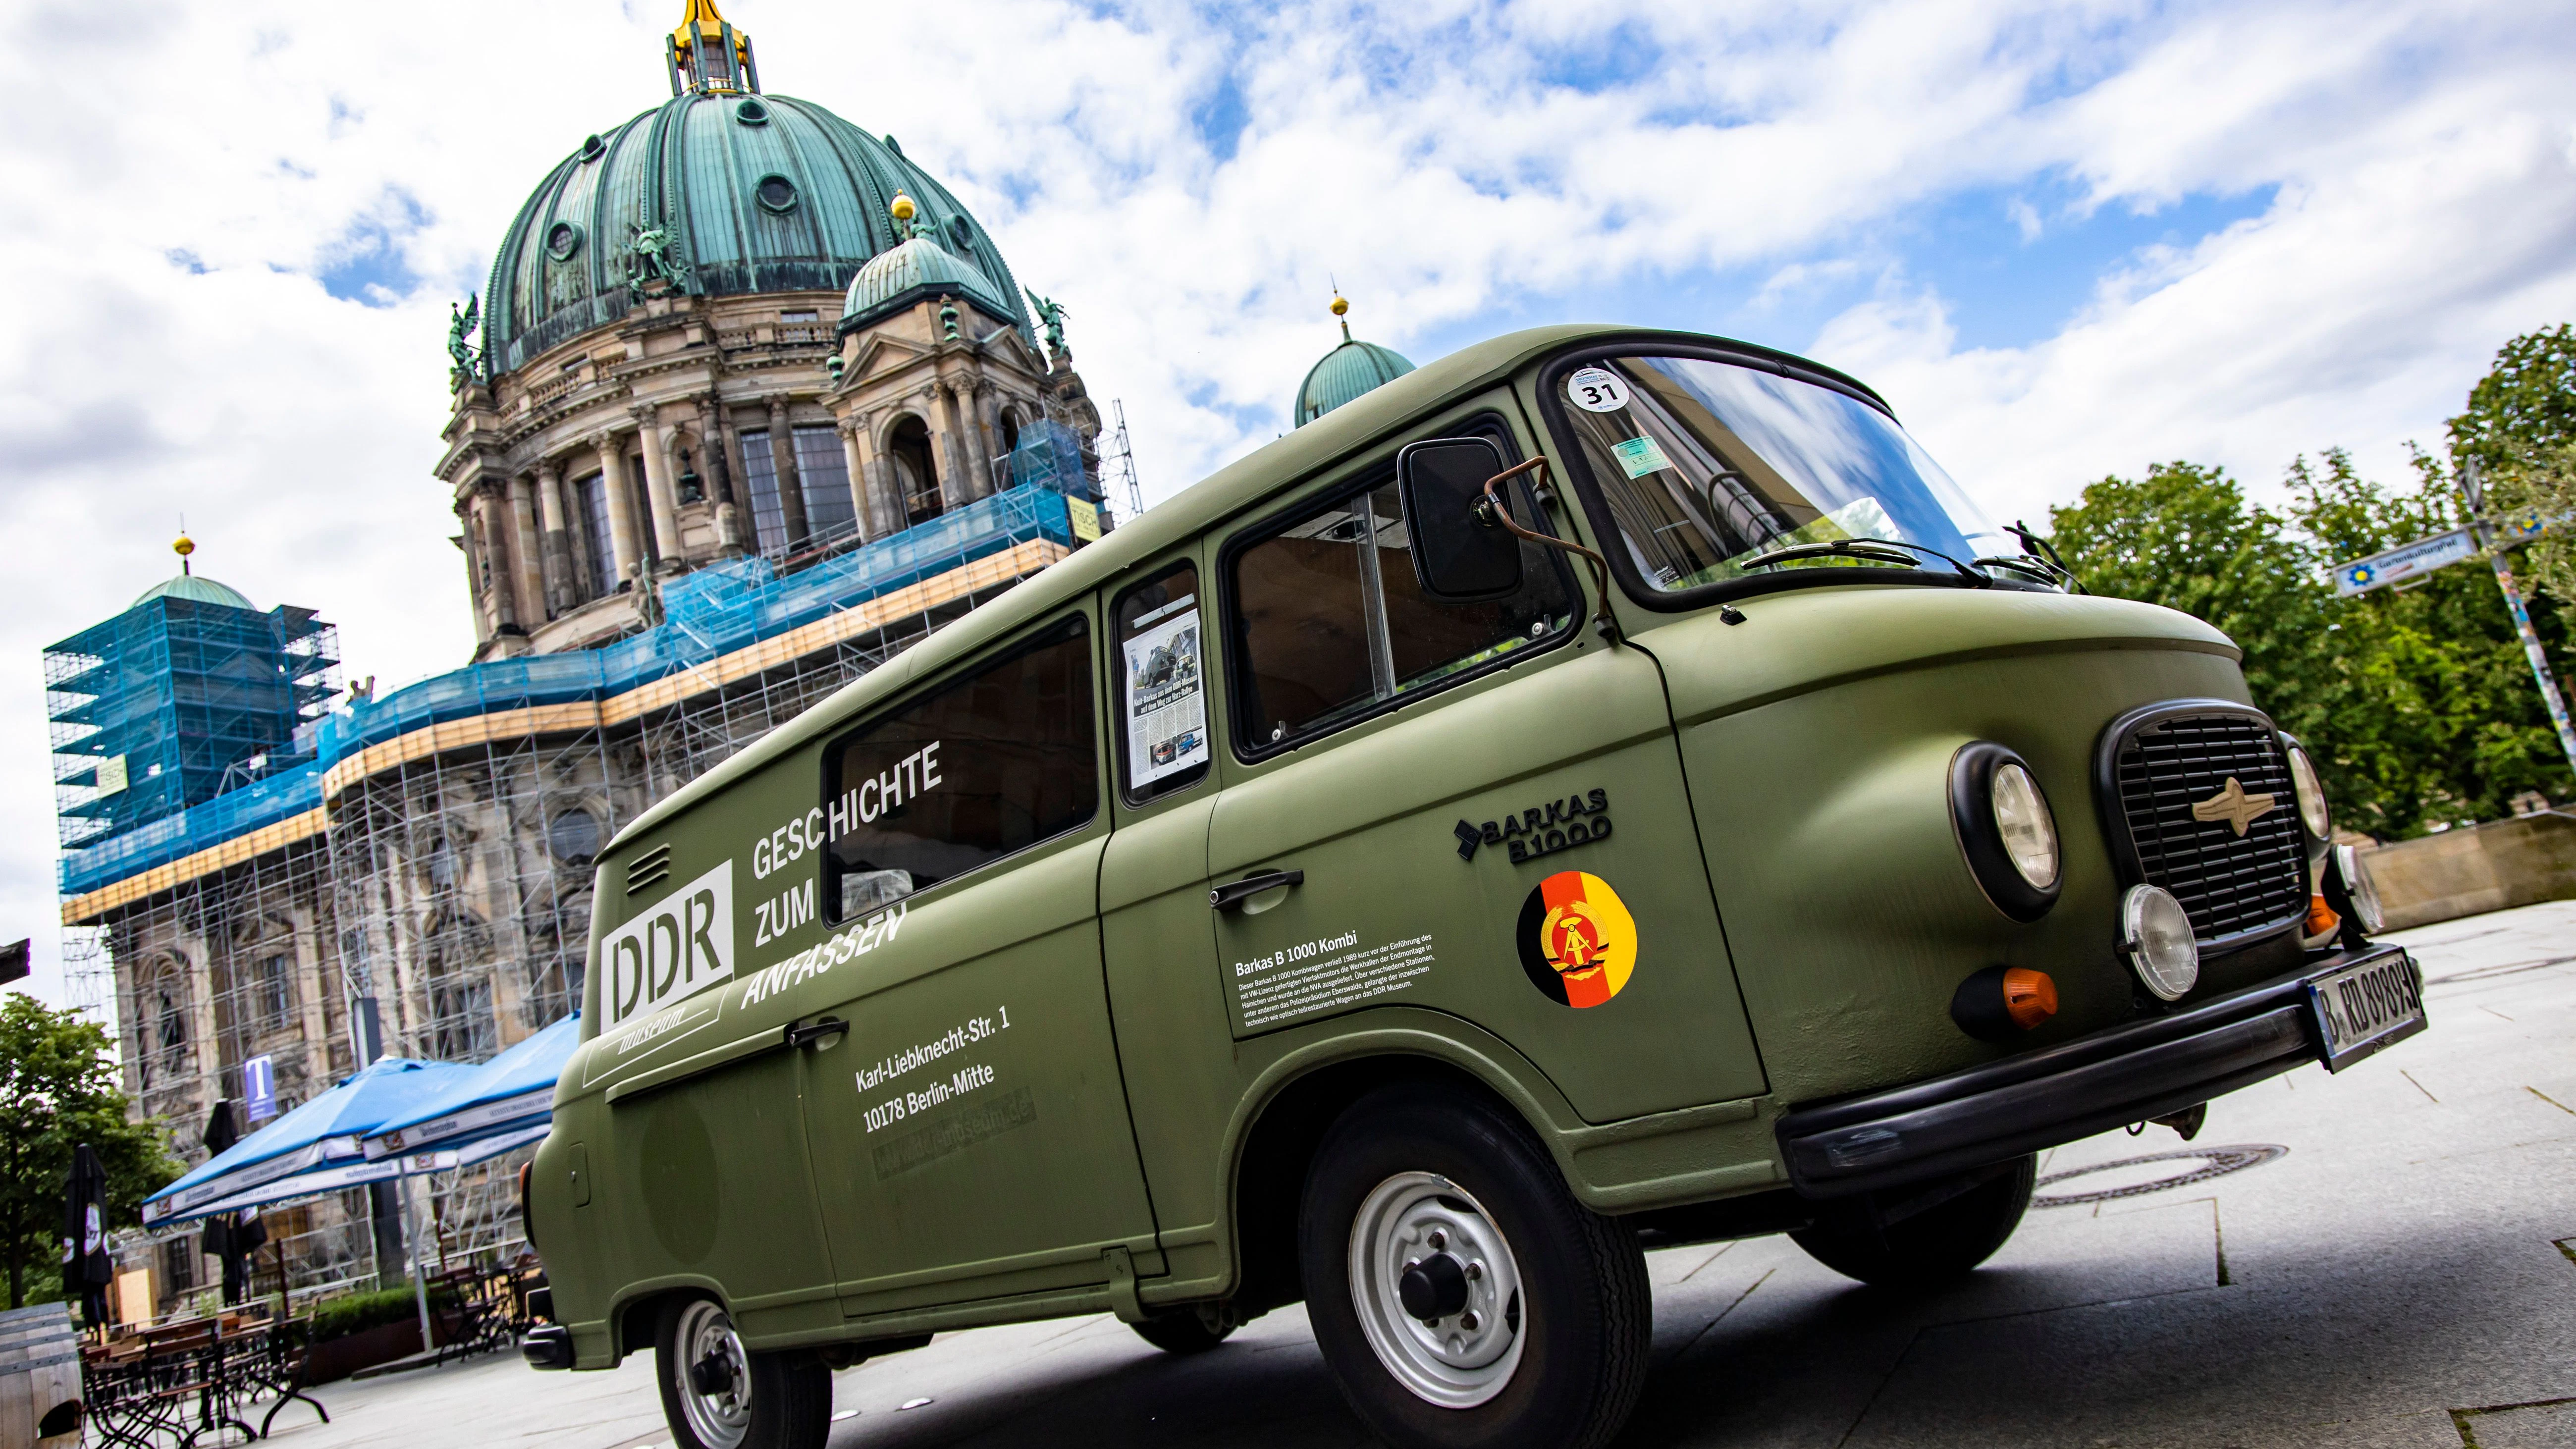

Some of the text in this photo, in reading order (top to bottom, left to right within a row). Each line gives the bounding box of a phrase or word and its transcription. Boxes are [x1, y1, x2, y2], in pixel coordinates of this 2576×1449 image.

[1582, 384, 1617, 405] 31
[1071, 509, 1098, 529] TISCH
[1134, 693, 1158, 707] Kult-Barkas
[1173, 675, 1198, 691] DDR-Museum
[1148, 702, 1157, 710] dem
[1157, 698, 1166, 706] Weg
[1172, 686, 1193, 701] Harz-Rallye
[753, 741, 941, 879] GESCHICHTE
[1481, 788, 1608, 844] BARKAS
[755, 878, 814, 948] ZUM
[613, 889, 721, 1024] DDR
[741, 901, 907, 1010] ANFASSEN
[1235, 930, 1357, 976] Barkas B 1000 Kombi
[1238, 982, 1254, 991] Dieser
[1254, 977, 1272, 986] Barkas
[1277, 971, 1290, 980] 1000
[1291, 964, 1324, 976] Kombiwagen
[1324, 957, 1342, 967] verließ
[1342, 953, 1357, 963] 1989
[1390, 937, 1421, 950] Einführung
[1248, 986, 1274, 997] VW-Lizenz
[1275, 979, 1301, 992] gefertigten
[1301, 969, 1340, 983] Viertaktmotors
[1349, 959, 1379, 970] Werkhallen
[1390, 947, 1425, 960] Endmontage
[1241, 998, 1267, 1009] Hainichen
[1277, 991, 1293, 999] wurde
[1310, 982, 1322, 991] NVA
[1322, 974, 1354, 988] ausgeliefert.
[1354, 971, 1368, 979] Über
[1369, 962, 1405, 975] verschiedene
[1405, 955, 1435, 966] Stationen,
[1245, 1016, 1269, 1027] technisch
[1335, 995, 1354, 1004] Wagen
[1373, 986, 1386, 995] DDR
[1387, 981, 1412, 991] Museum.
[1257, 1005, 1280, 1015] anderem
[1289, 991, 1331, 1006] Polizeipräsidium
[1332, 982, 1363, 995] Eberswalde,
[1364, 976, 1388, 988] gelangte
[1398, 966, 1429, 978] inzwischen
[618, 1007, 687, 1055] museum
[2317, 988, 2340, 1045] B
[2337, 976, 2369, 1035] RD
[856, 1005, 1010, 1093] Karl-Liebknecht-Str. 1
[246, 1054, 272, 1101] T
[863, 1064, 994, 1133] 10178 Berlin-Mitte
